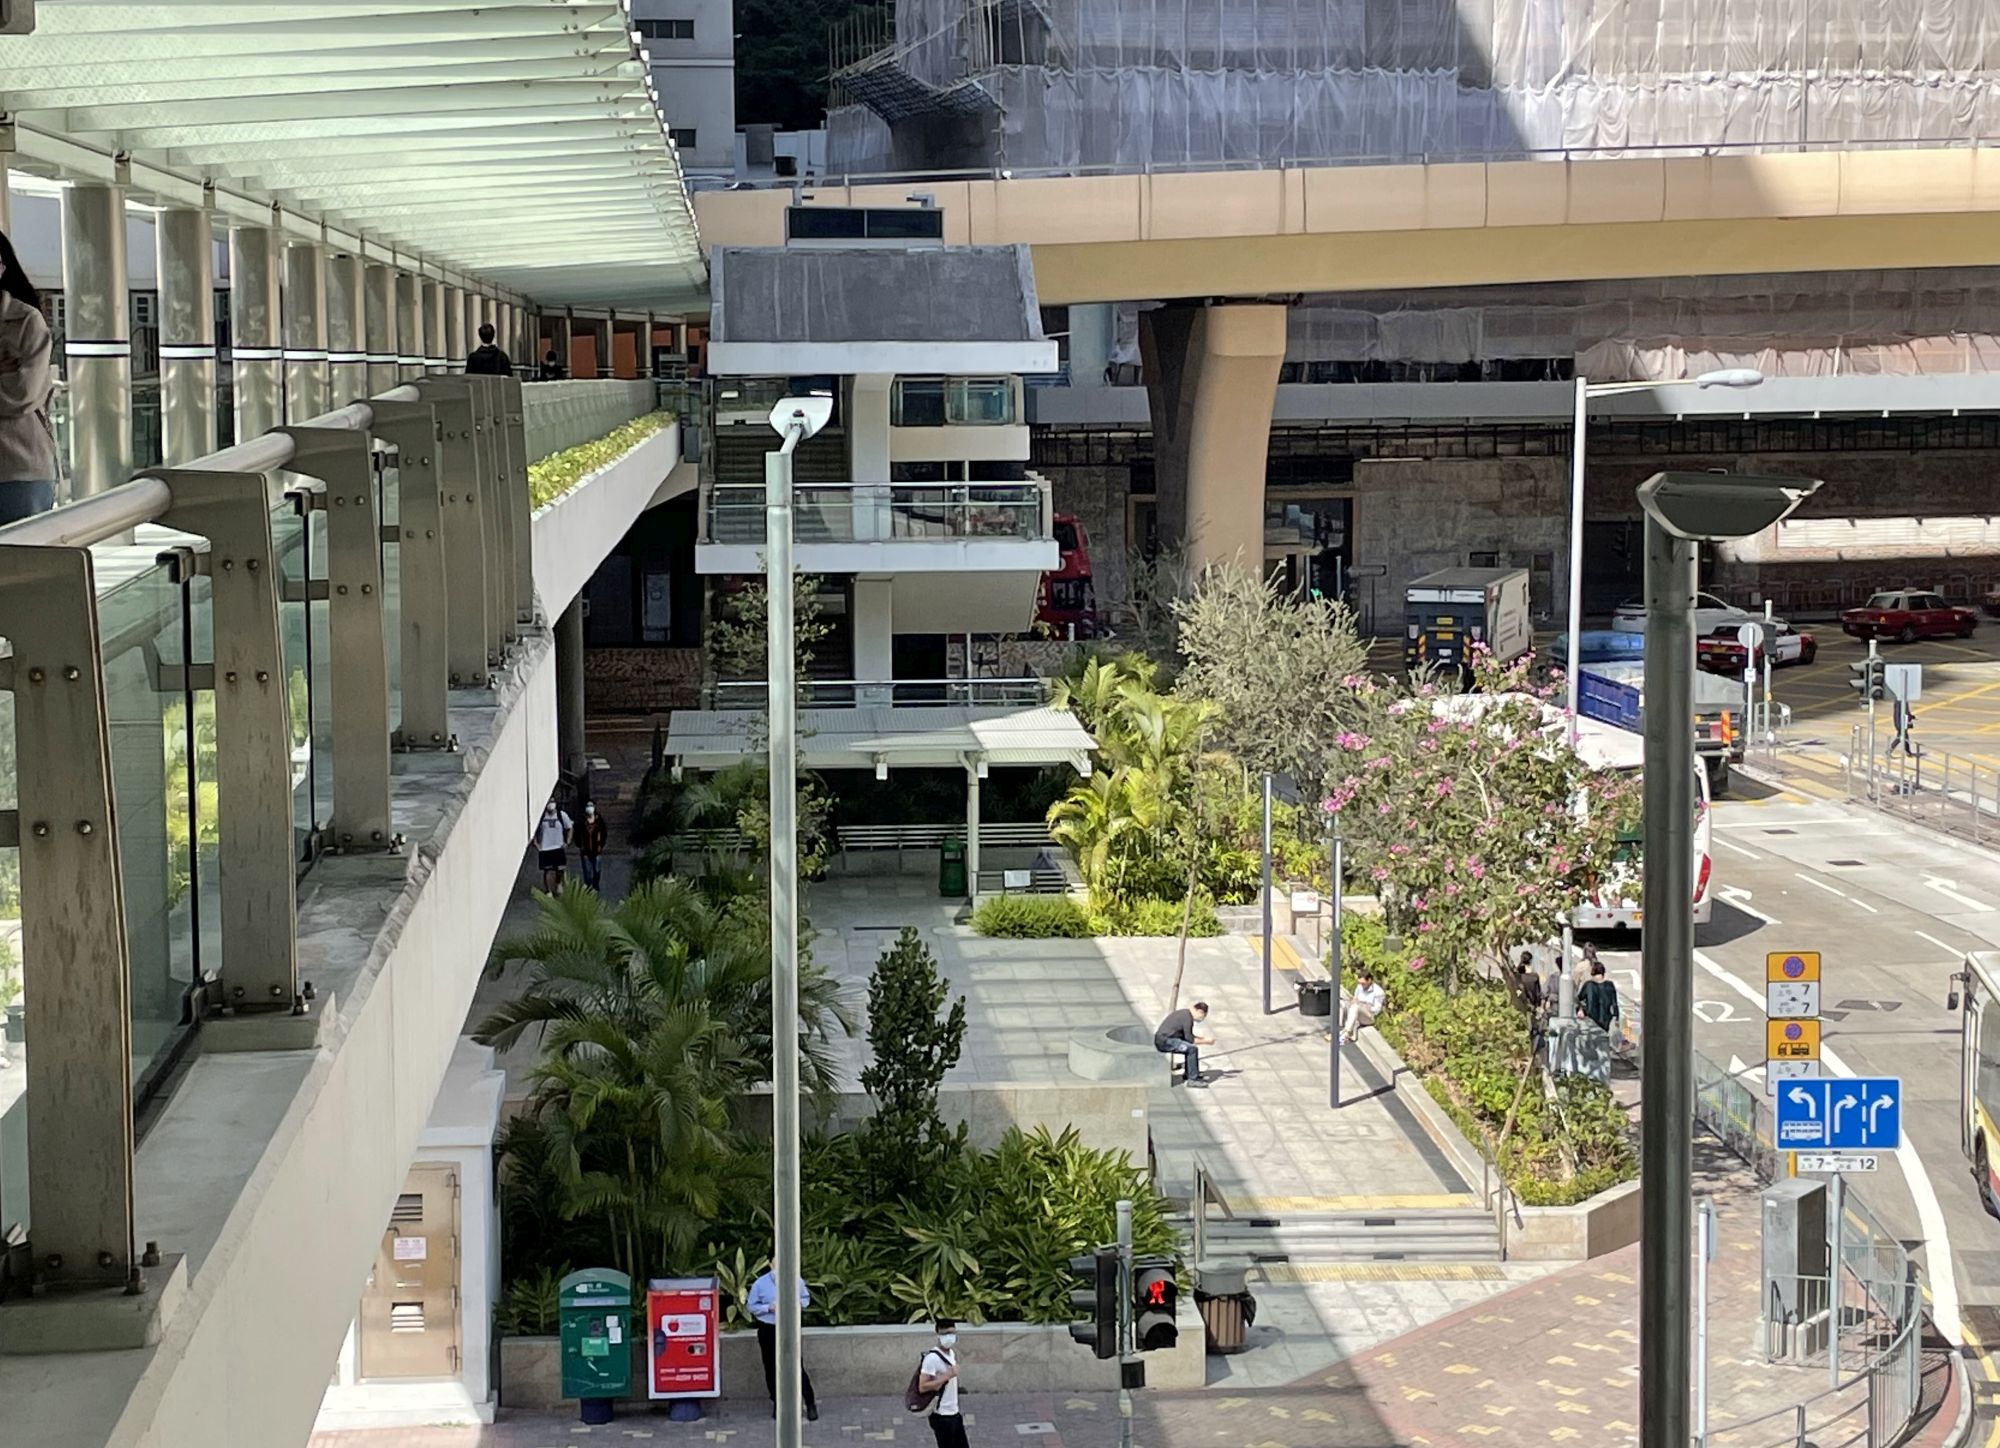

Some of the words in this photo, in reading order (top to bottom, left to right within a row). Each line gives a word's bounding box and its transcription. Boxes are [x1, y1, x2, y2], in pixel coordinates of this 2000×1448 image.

[1801, 984, 1810, 995] 7
[1801, 1002, 1810, 1013] 7
[1800, 1062, 1810, 1073] 7
[1859, 1158, 1875, 1170] 12
